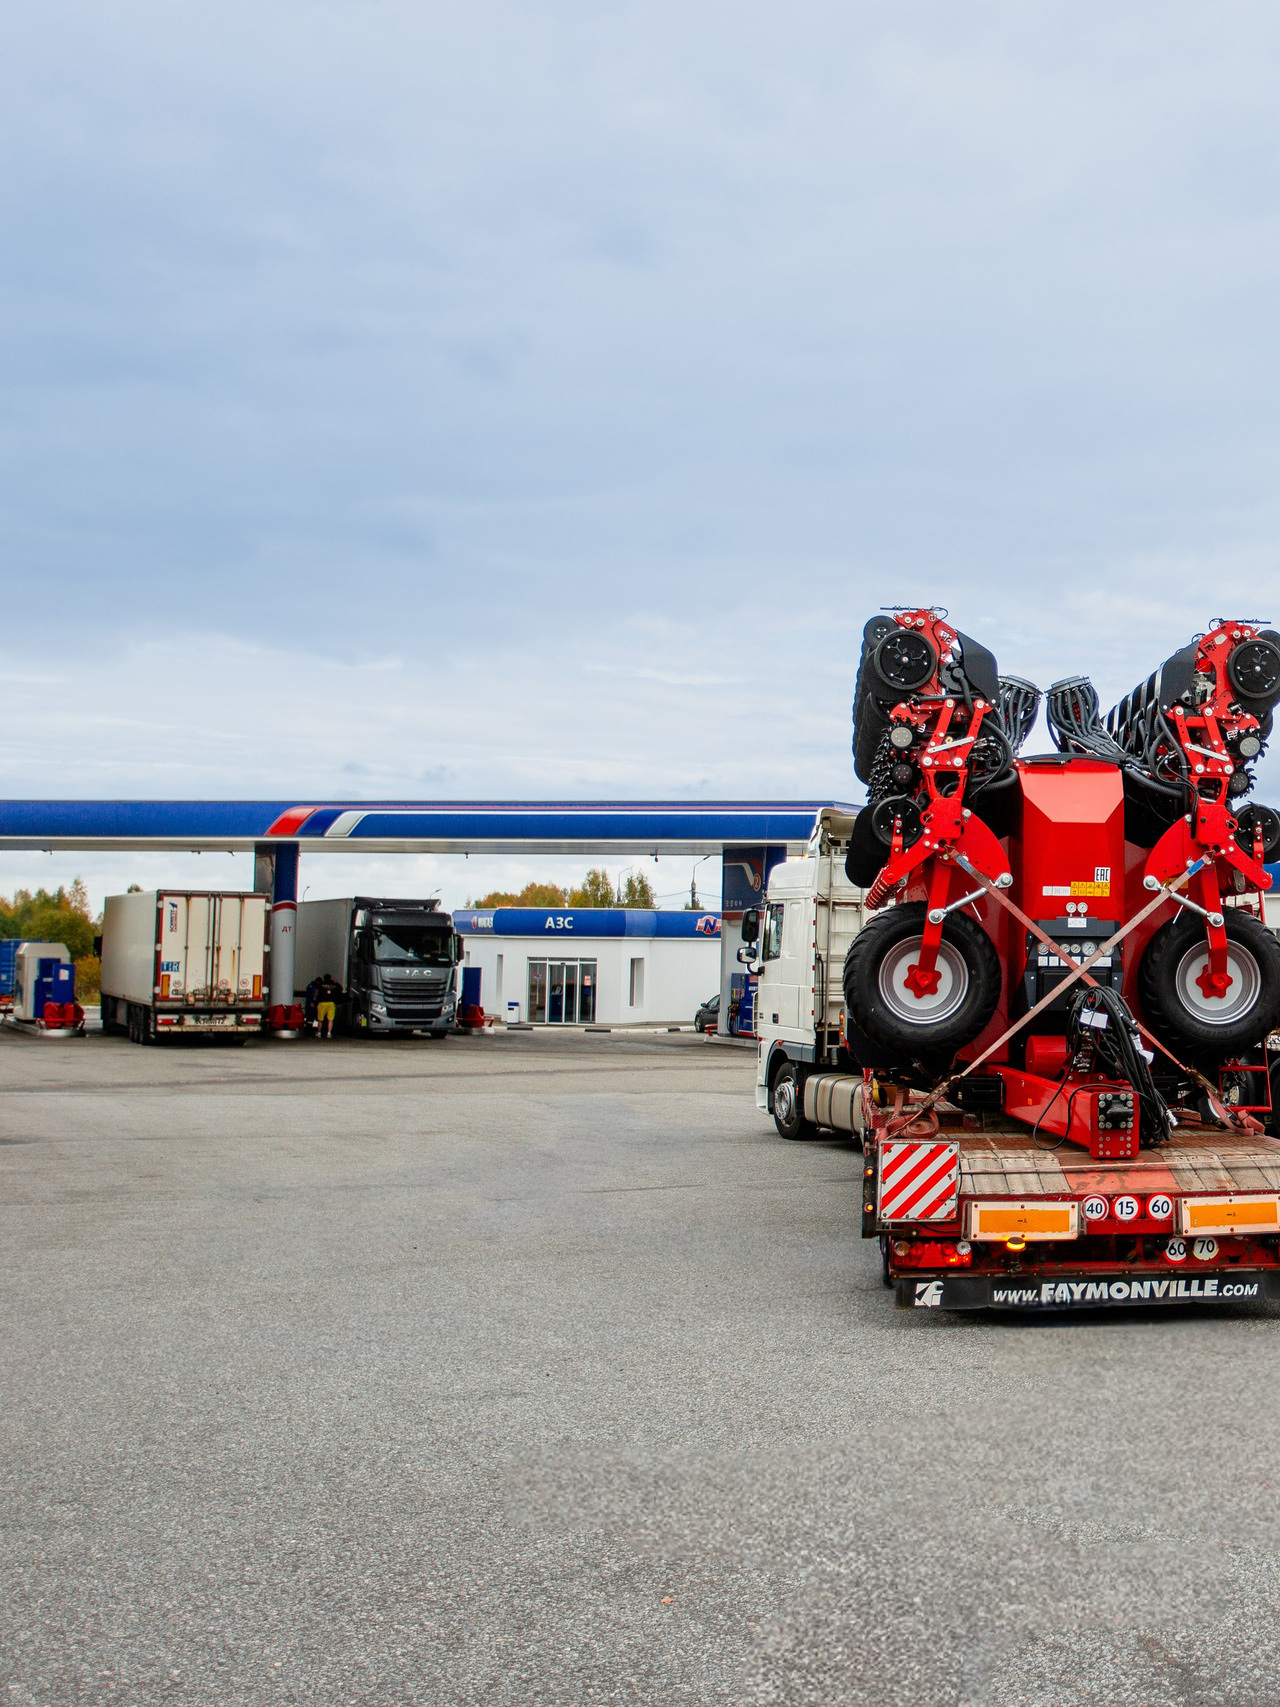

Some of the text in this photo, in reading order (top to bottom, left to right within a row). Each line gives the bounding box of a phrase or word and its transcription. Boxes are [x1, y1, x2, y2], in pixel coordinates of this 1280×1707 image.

[1096, 868, 1109, 881] EAC
[281, 925, 293, 933] ДТ
[544, 916, 574, 929] АЗС
[162, 962, 179, 971] TIR
[1086, 1202, 1103, 1214] 40
[1118, 1201, 1134, 1215] 15
[1152, 1200, 1170, 1213] 60
[1168, 1242, 1186, 1255] 60
[1198, 1240, 1215, 1253] 70
